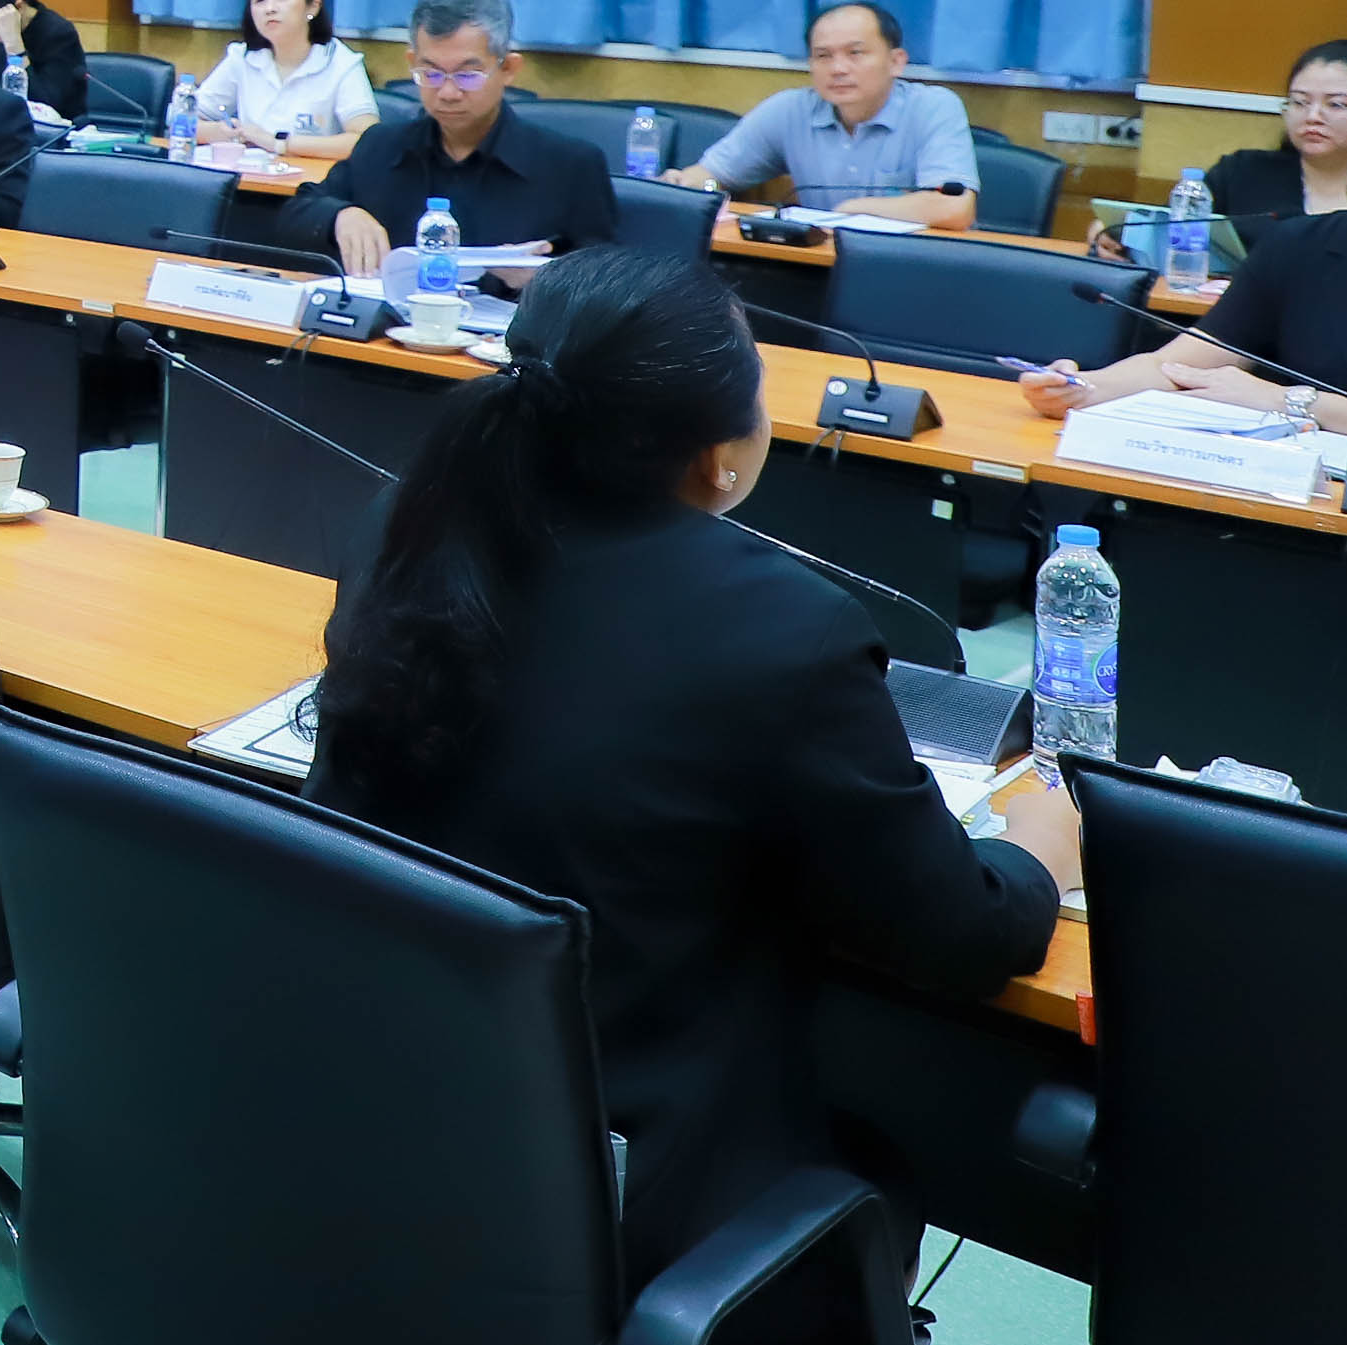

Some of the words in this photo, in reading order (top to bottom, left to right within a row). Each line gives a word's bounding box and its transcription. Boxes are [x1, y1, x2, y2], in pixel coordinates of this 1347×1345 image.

[1124, 437, 1244, 467] กรมวิชาการเกษตร
